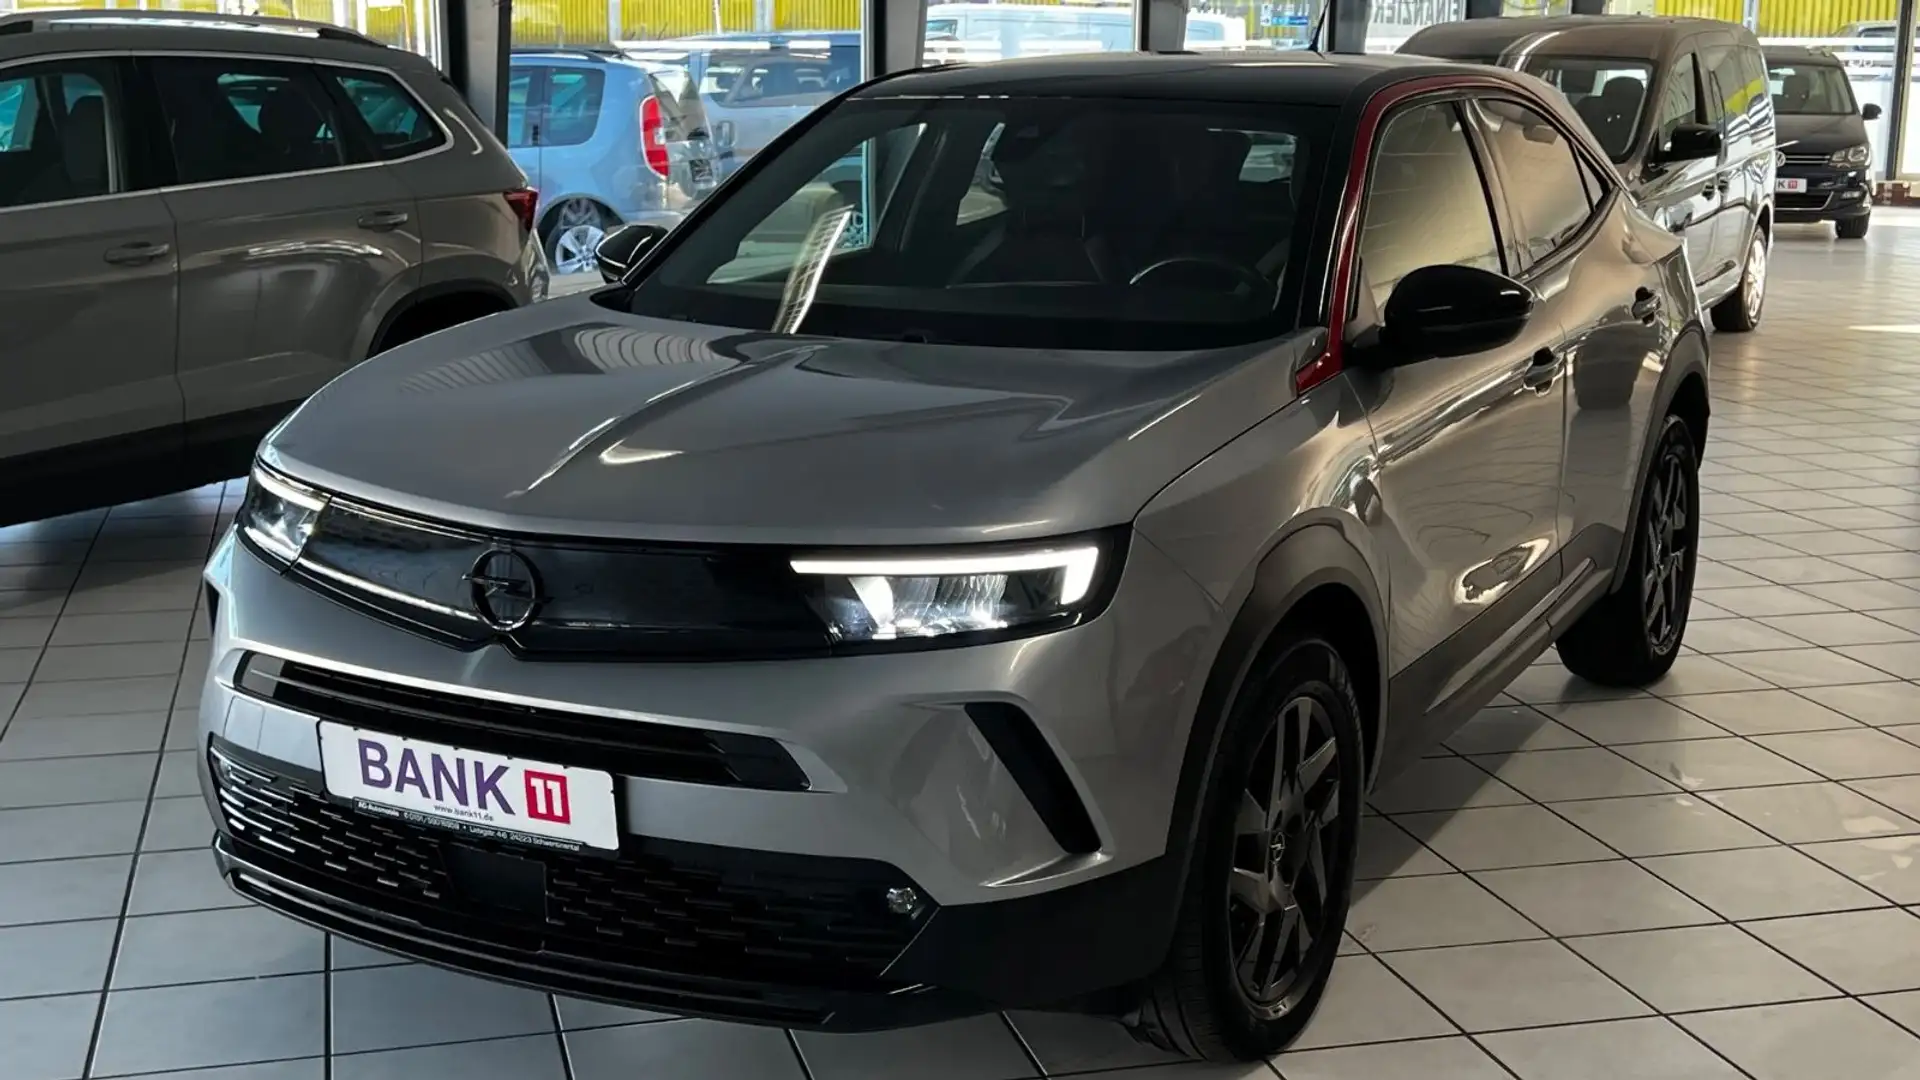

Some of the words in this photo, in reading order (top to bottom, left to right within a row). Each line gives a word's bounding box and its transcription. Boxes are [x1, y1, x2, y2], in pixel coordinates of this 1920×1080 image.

[358, 738, 516, 816] BANK
[530, 777, 563, 818] 11
[433, 804, 494, 822] www.bank11.de
